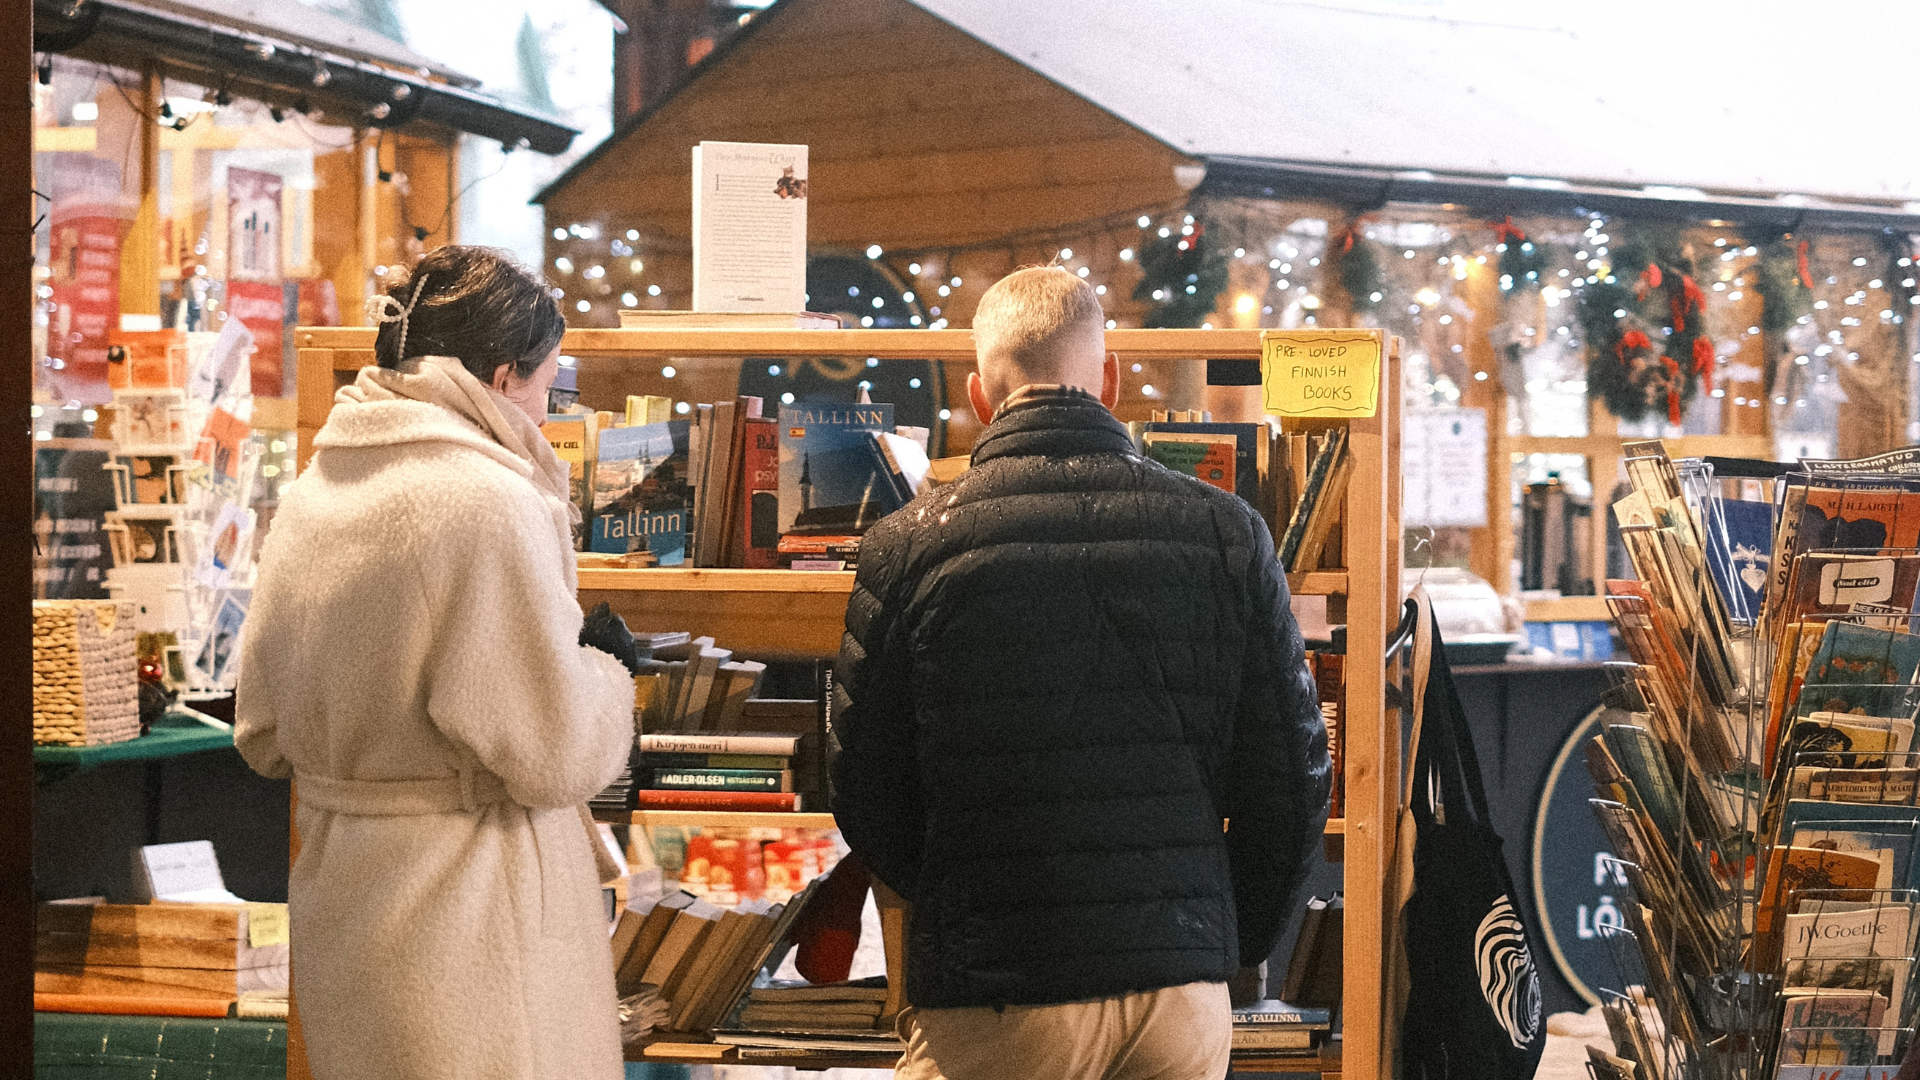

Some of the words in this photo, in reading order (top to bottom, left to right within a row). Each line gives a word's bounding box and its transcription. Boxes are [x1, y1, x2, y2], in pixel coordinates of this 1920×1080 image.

[1309, 346, 1347, 358] LOVED
[1291, 365, 1347, 378] FINNISH
[1303, 384, 1352, 401] BOOKS
[792, 410, 884, 424] TALLINN
[1814, 453, 1914, 470] LASTERAAMATUD
[601, 510, 681, 539] Tallinn
[825, 668, 833, 689] TIMO
